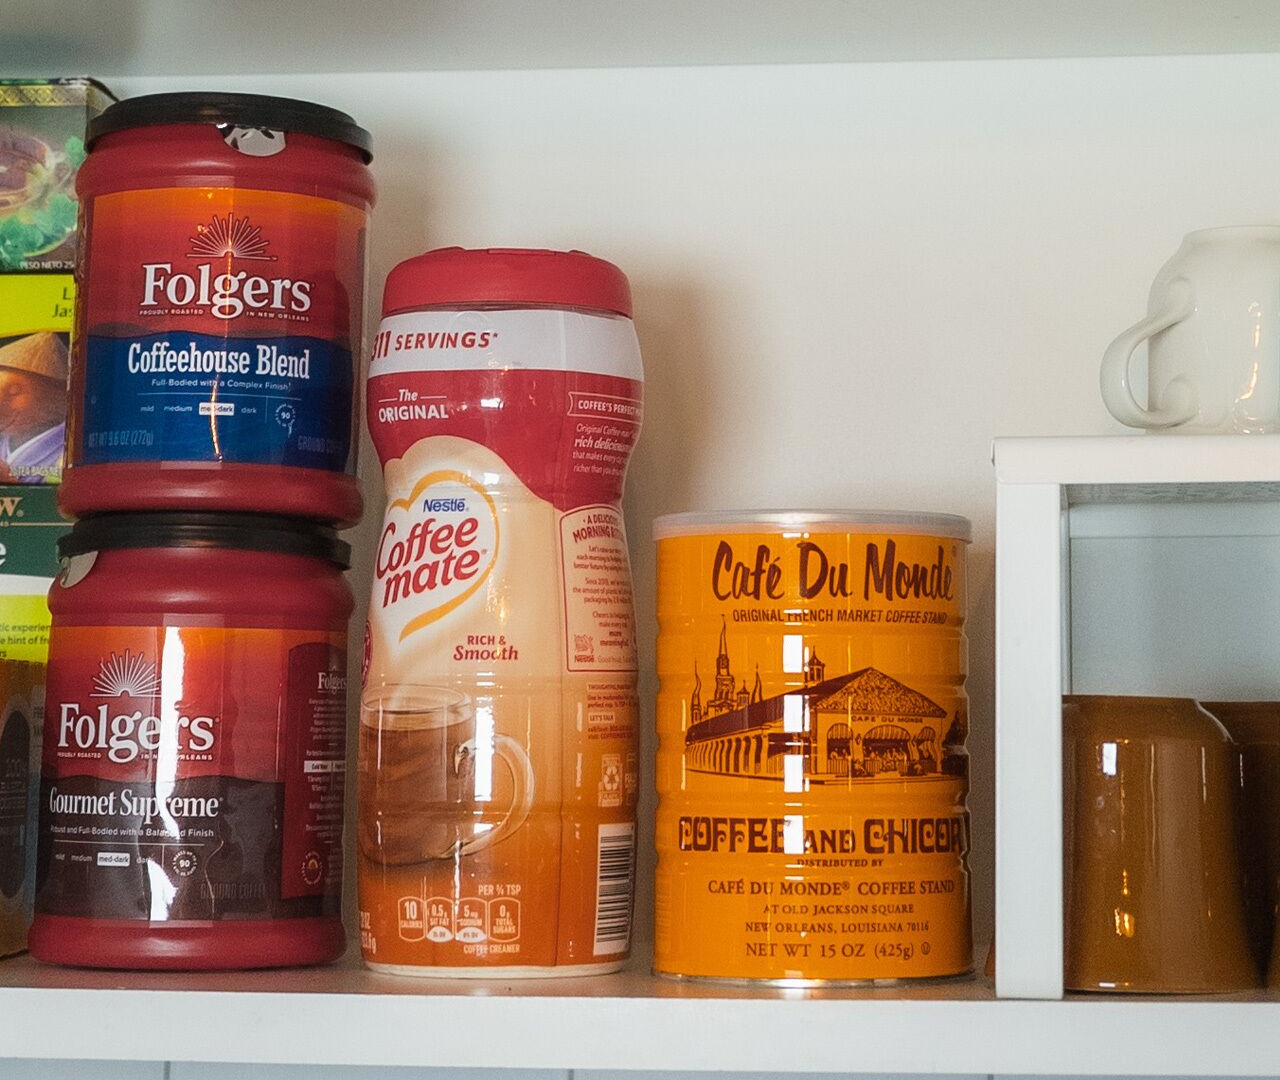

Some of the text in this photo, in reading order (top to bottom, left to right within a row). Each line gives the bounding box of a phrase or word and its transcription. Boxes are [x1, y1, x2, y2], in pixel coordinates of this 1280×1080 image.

[140, 262, 312, 319] Folgers
[170, 308, 204, 316] ROASTED
[278, 313, 310, 322] ORLEANS
[127, 341, 310, 379] Coffeehouse Blend
[151, 378, 198, 387] Full-Bodied
[200, 379, 218, 387] with
[227, 379, 263, 389] Complex
[398, 389, 418, 401] The
[241, 406, 257, 414] dark
[578, 400, 612, 412] COFFEE'S
[280, 411, 291, 420] 90
[378, 404, 449, 423] ORIGINAL
[576, 423, 602, 436] Original
[574, 435, 593, 448] rich
[423, 497, 467, 513] Nestlé
[376, 516, 479, 577] Coffee
[712, 539, 954, 601] Café Du Monde
[382, 549, 481, 608] mate
[732, 609, 948, 625] ORIGINAL FRENCH MARKET COFFEE STAND
[11, 622, 50, 633] experien
[7, 635, 26, 645] hint
[27, 635, 38, 645] of
[467, 635, 507, 646] RICH &
[453, 645, 519, 662] Smooth
[57, 702, 217, 763] Folgers
[50, 786, 117, 816] Gourmet
[78, 826, 214, 837] Full-Bodied with Finish
[678, 816, 962, 855] COFFEE AND CHICOR
[98, 855, 130, 863] med-dark
[797, 859, 884, 868] DISTRIBUTED BY
[478, 884, 521, 896] PER TSP
[708, 878, 744, 895] CAFÉ
[750, 881, 774, 895] DU
[857, 881, 916, 895] COFFEE
[919, 880, 955, 895] STAND
[404, 901, 417, 920] 10
[763, 904, 914, 916] AT OLD JACKSON SQUARE
[745, 921, 929, 934] NEW ORLEANS, LOUISIANA 70116
[463, 944, 520, 954] COFFEE CREAMER
[746, 942, 914, 961] NET WT 15 OZ (425g)
